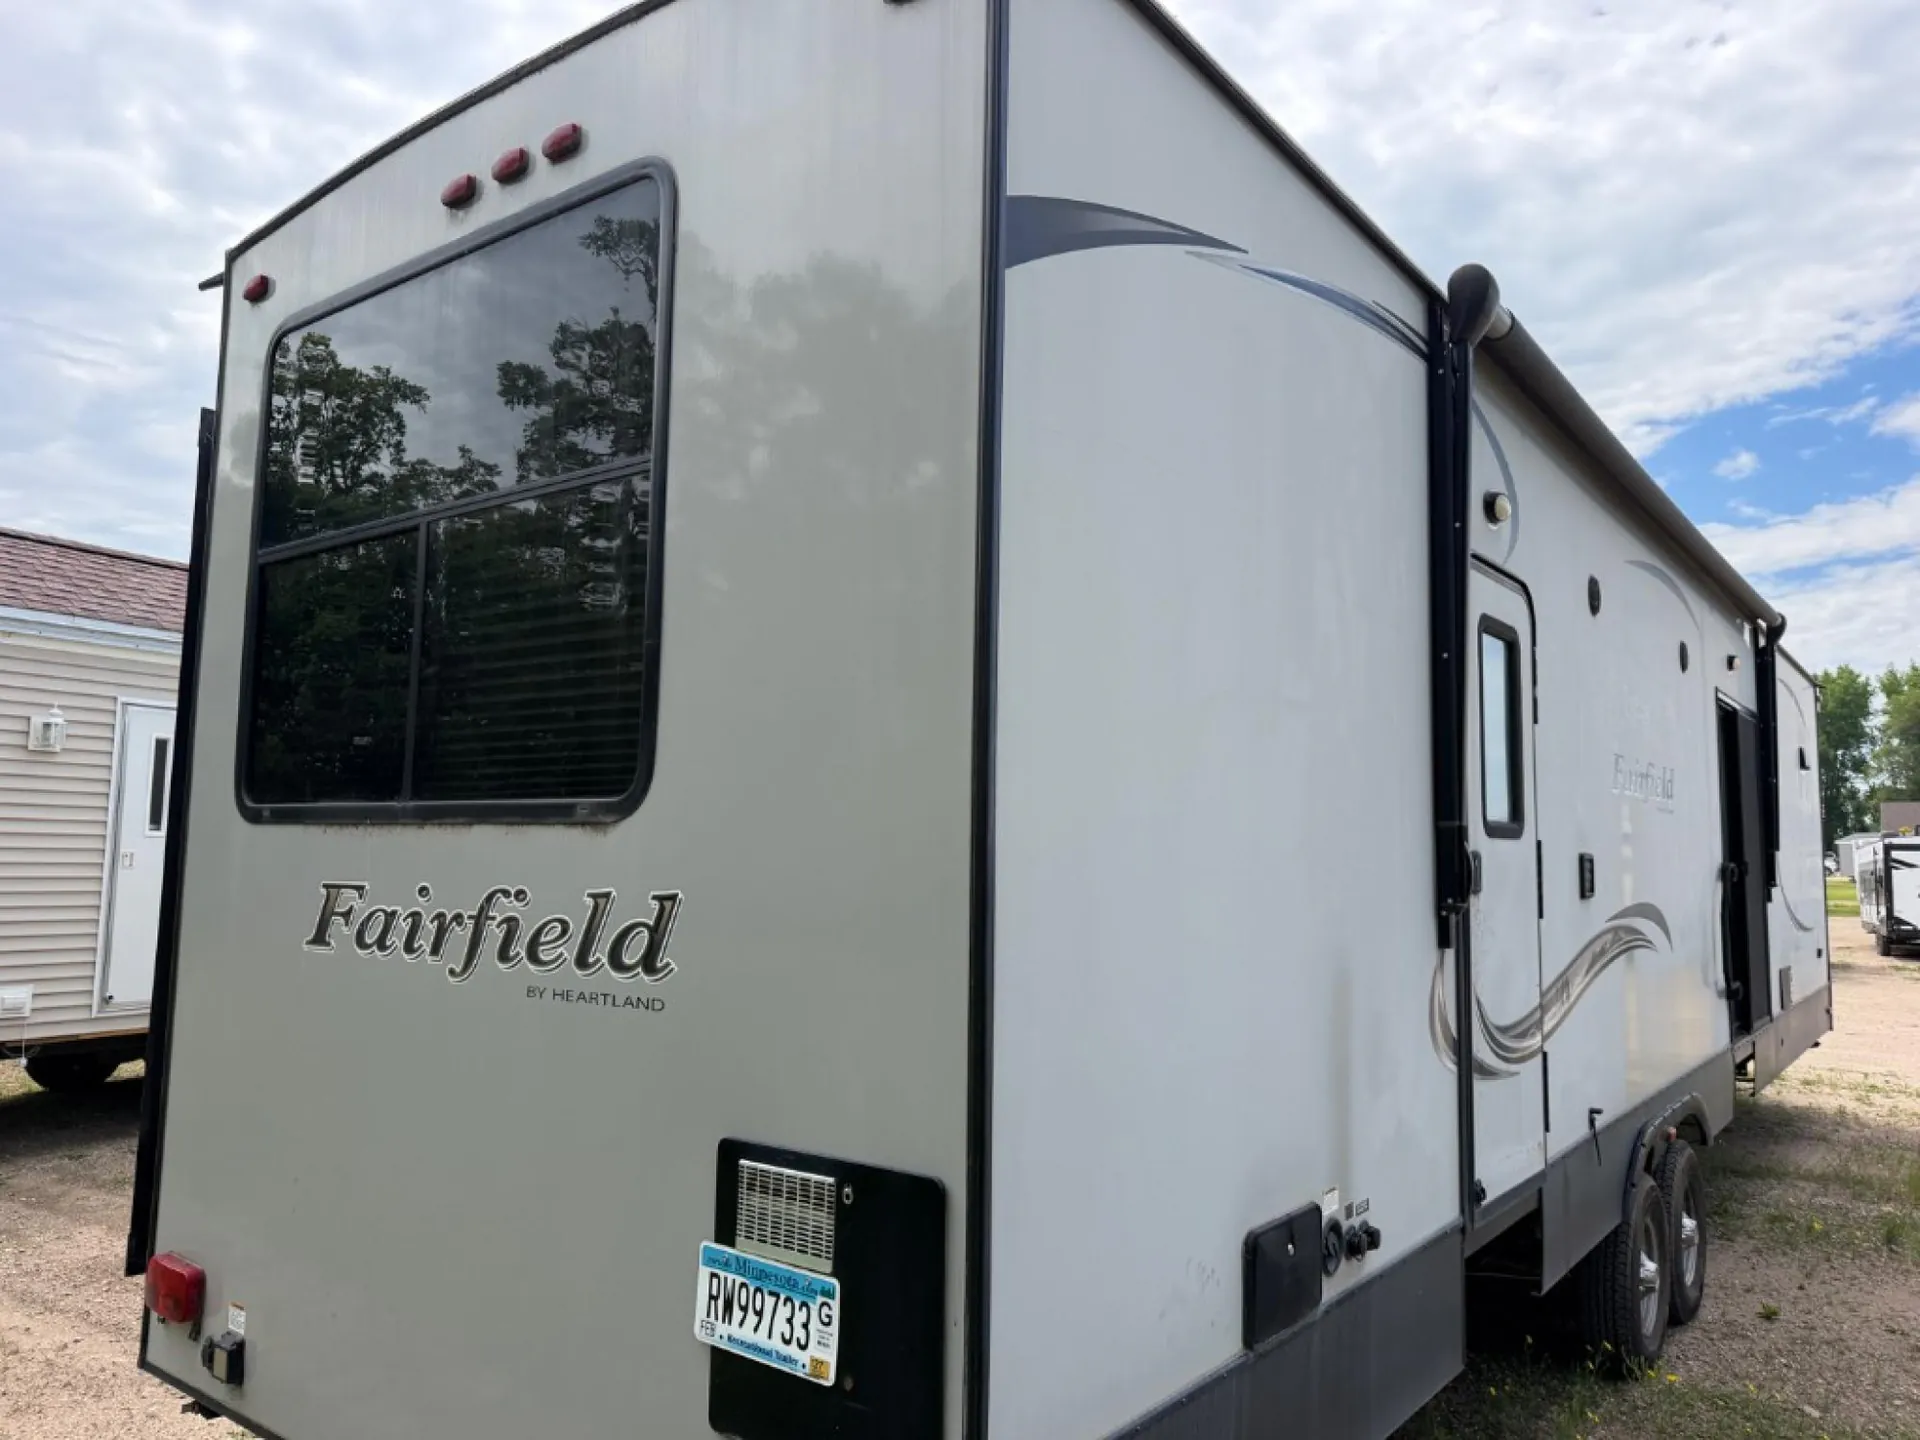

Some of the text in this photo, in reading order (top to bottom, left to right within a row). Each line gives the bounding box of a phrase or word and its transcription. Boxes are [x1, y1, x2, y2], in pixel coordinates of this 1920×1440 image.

[303, 880, 685, 984] Fairfield
[526, 985, 665, 1013] BY HEARTLAND
[706, 1272, 811, 1352] RW99733
[818, 1301, 834, 1328] G
